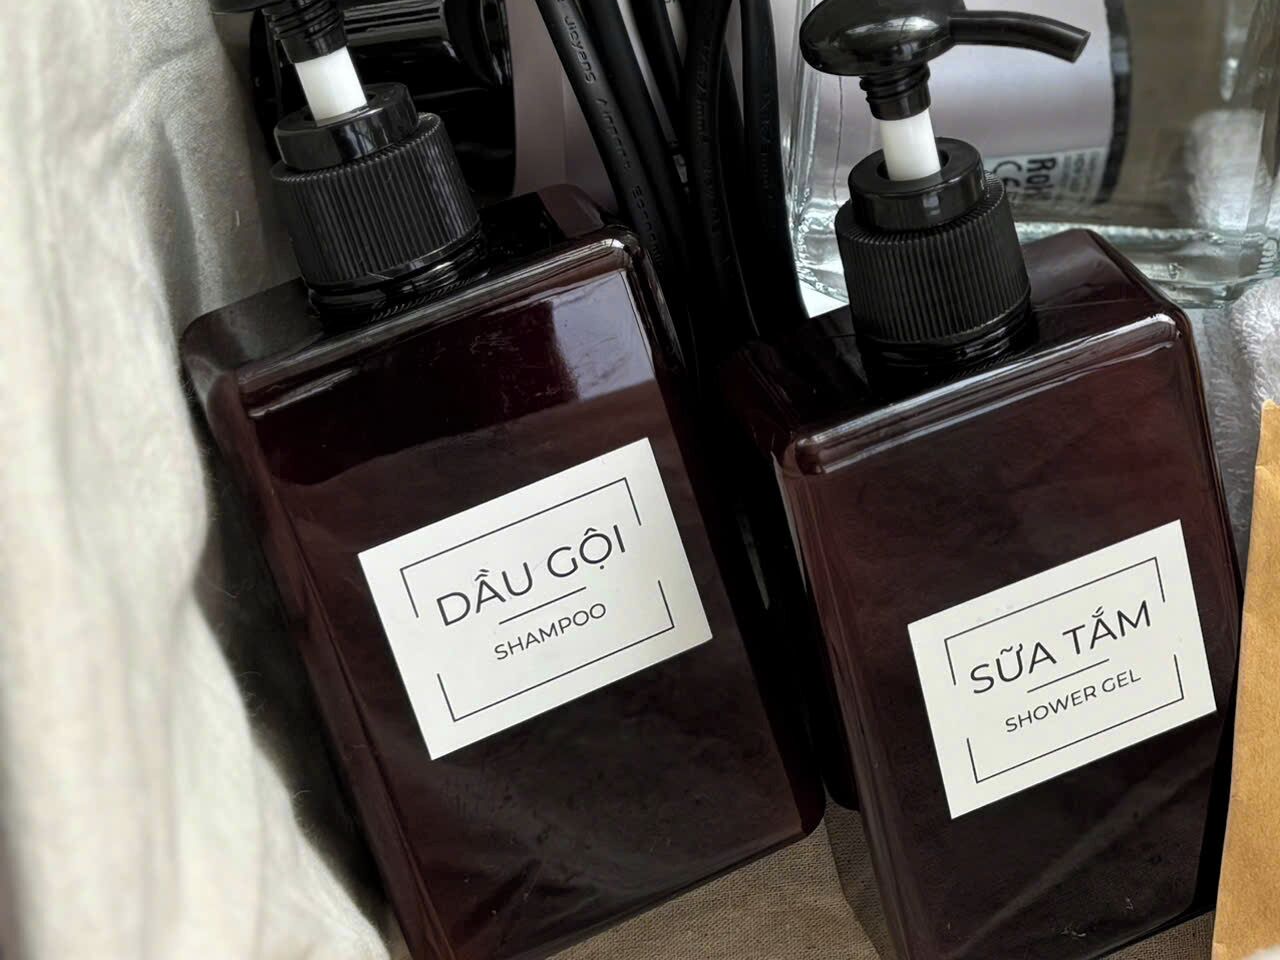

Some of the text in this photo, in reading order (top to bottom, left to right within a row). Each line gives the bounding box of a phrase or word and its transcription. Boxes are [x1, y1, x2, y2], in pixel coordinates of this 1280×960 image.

[436, 524, 627, 627] DẦU GỘI
[493, 602, 607, 661] SHAMPOO
[969, 600, 1152, 695] SỮA TẮM
[1004, 668, 1142, 733] SHOWER GEL
